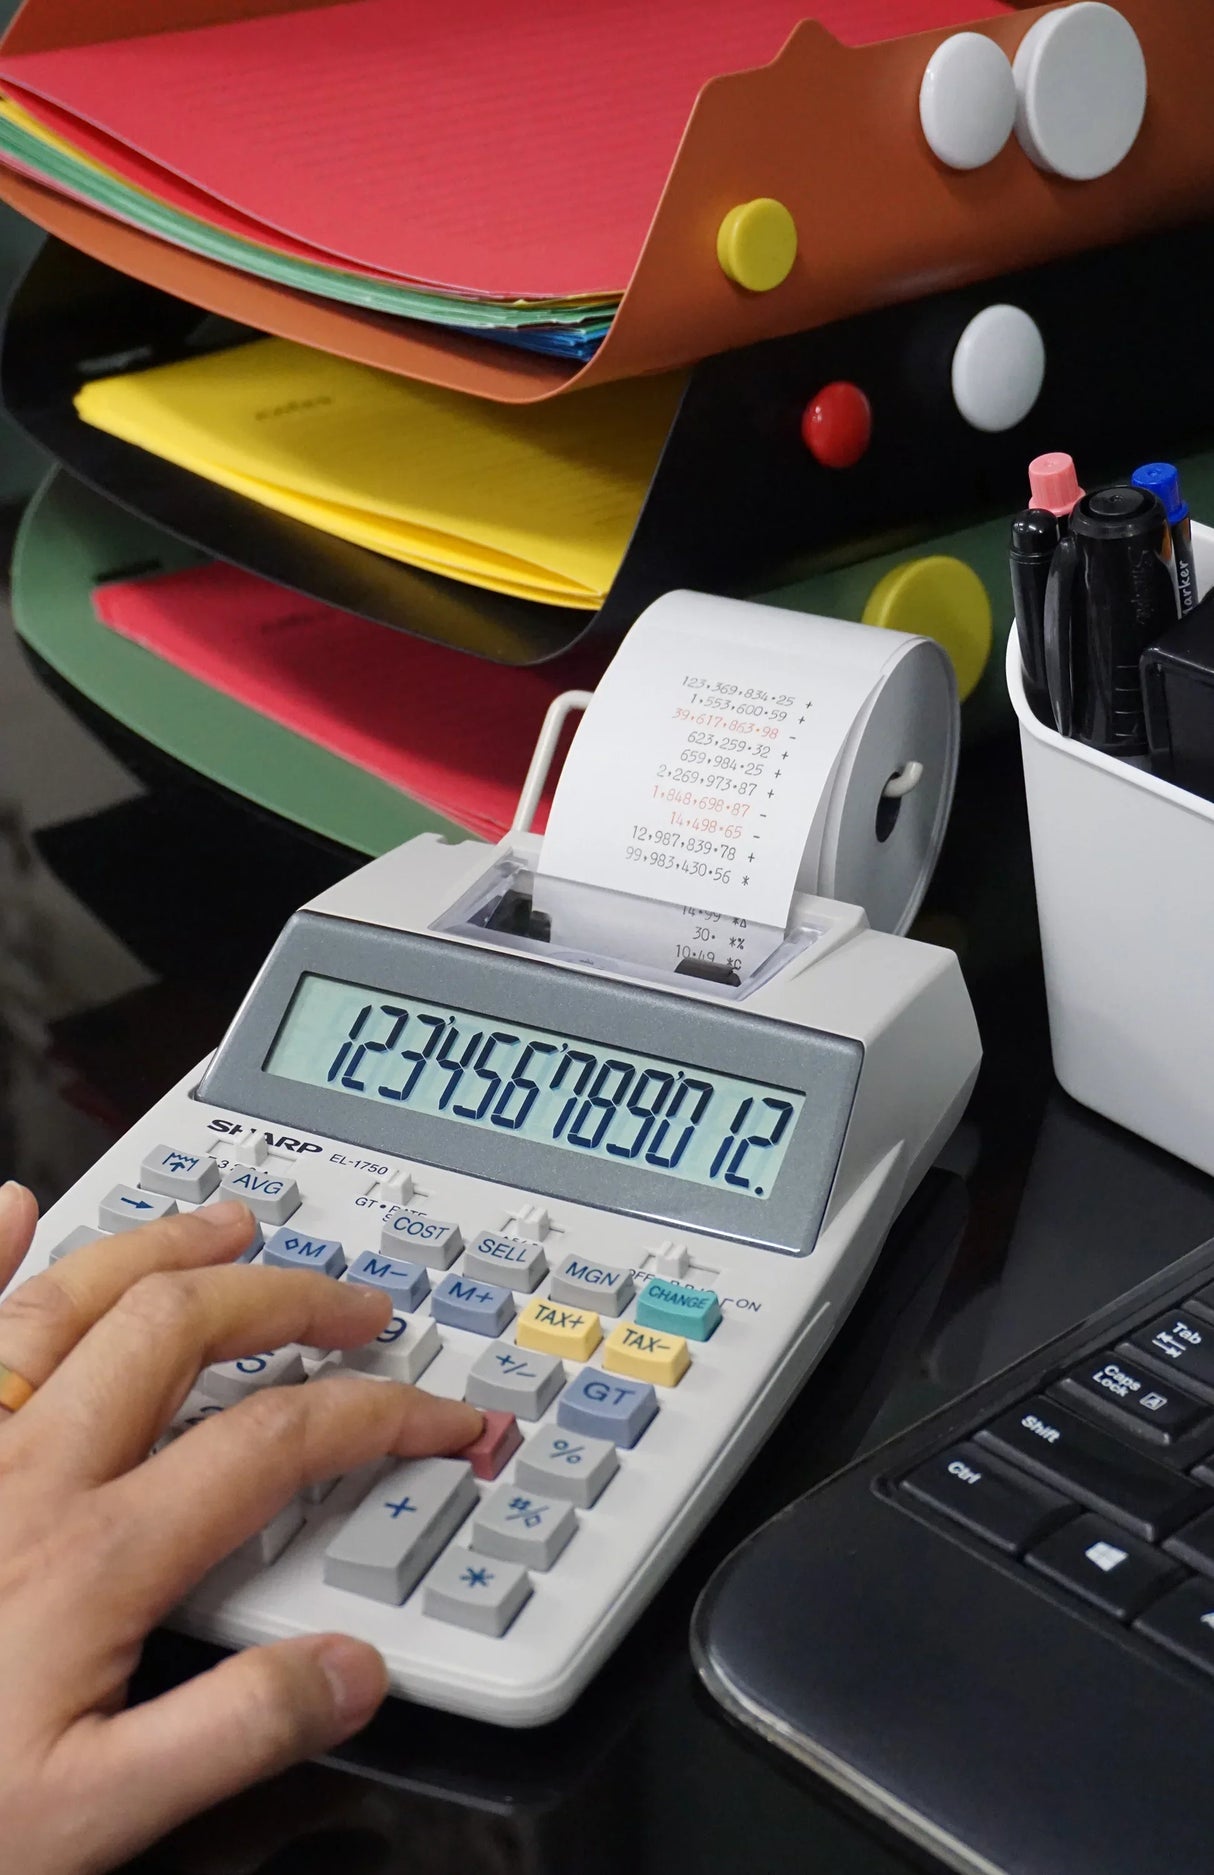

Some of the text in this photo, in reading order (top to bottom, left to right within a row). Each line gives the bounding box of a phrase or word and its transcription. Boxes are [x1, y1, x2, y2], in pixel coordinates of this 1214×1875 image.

[1179, 560, 1194, 615] arker
[329, 1154, 389, 1175] EL-1750
[232, 1173, 284, 1195] AVG
[393, 1216, 451, 1240] COST
[478, 1237, 528, 1263] SELL
[565, 1261, 620, 1286] MGN
[448, 1281, 494, 1303] M+
[648, 1284, 710, 1310] CHANGE
[534, 1304, 585, 1329] TAX+
[736, 1299, 763, 1312] ON
[1172, 1321, 1202, 1345] Tab
[1092, 1371, 1129, 1397] Lock
[1104, 1364, 1141, 1392] Caps
[583, 1381, 636, 1405] GT
[1021, 1415, 1060, 1443] Shift
[948, 1461, 982, 1485] Ctrl
